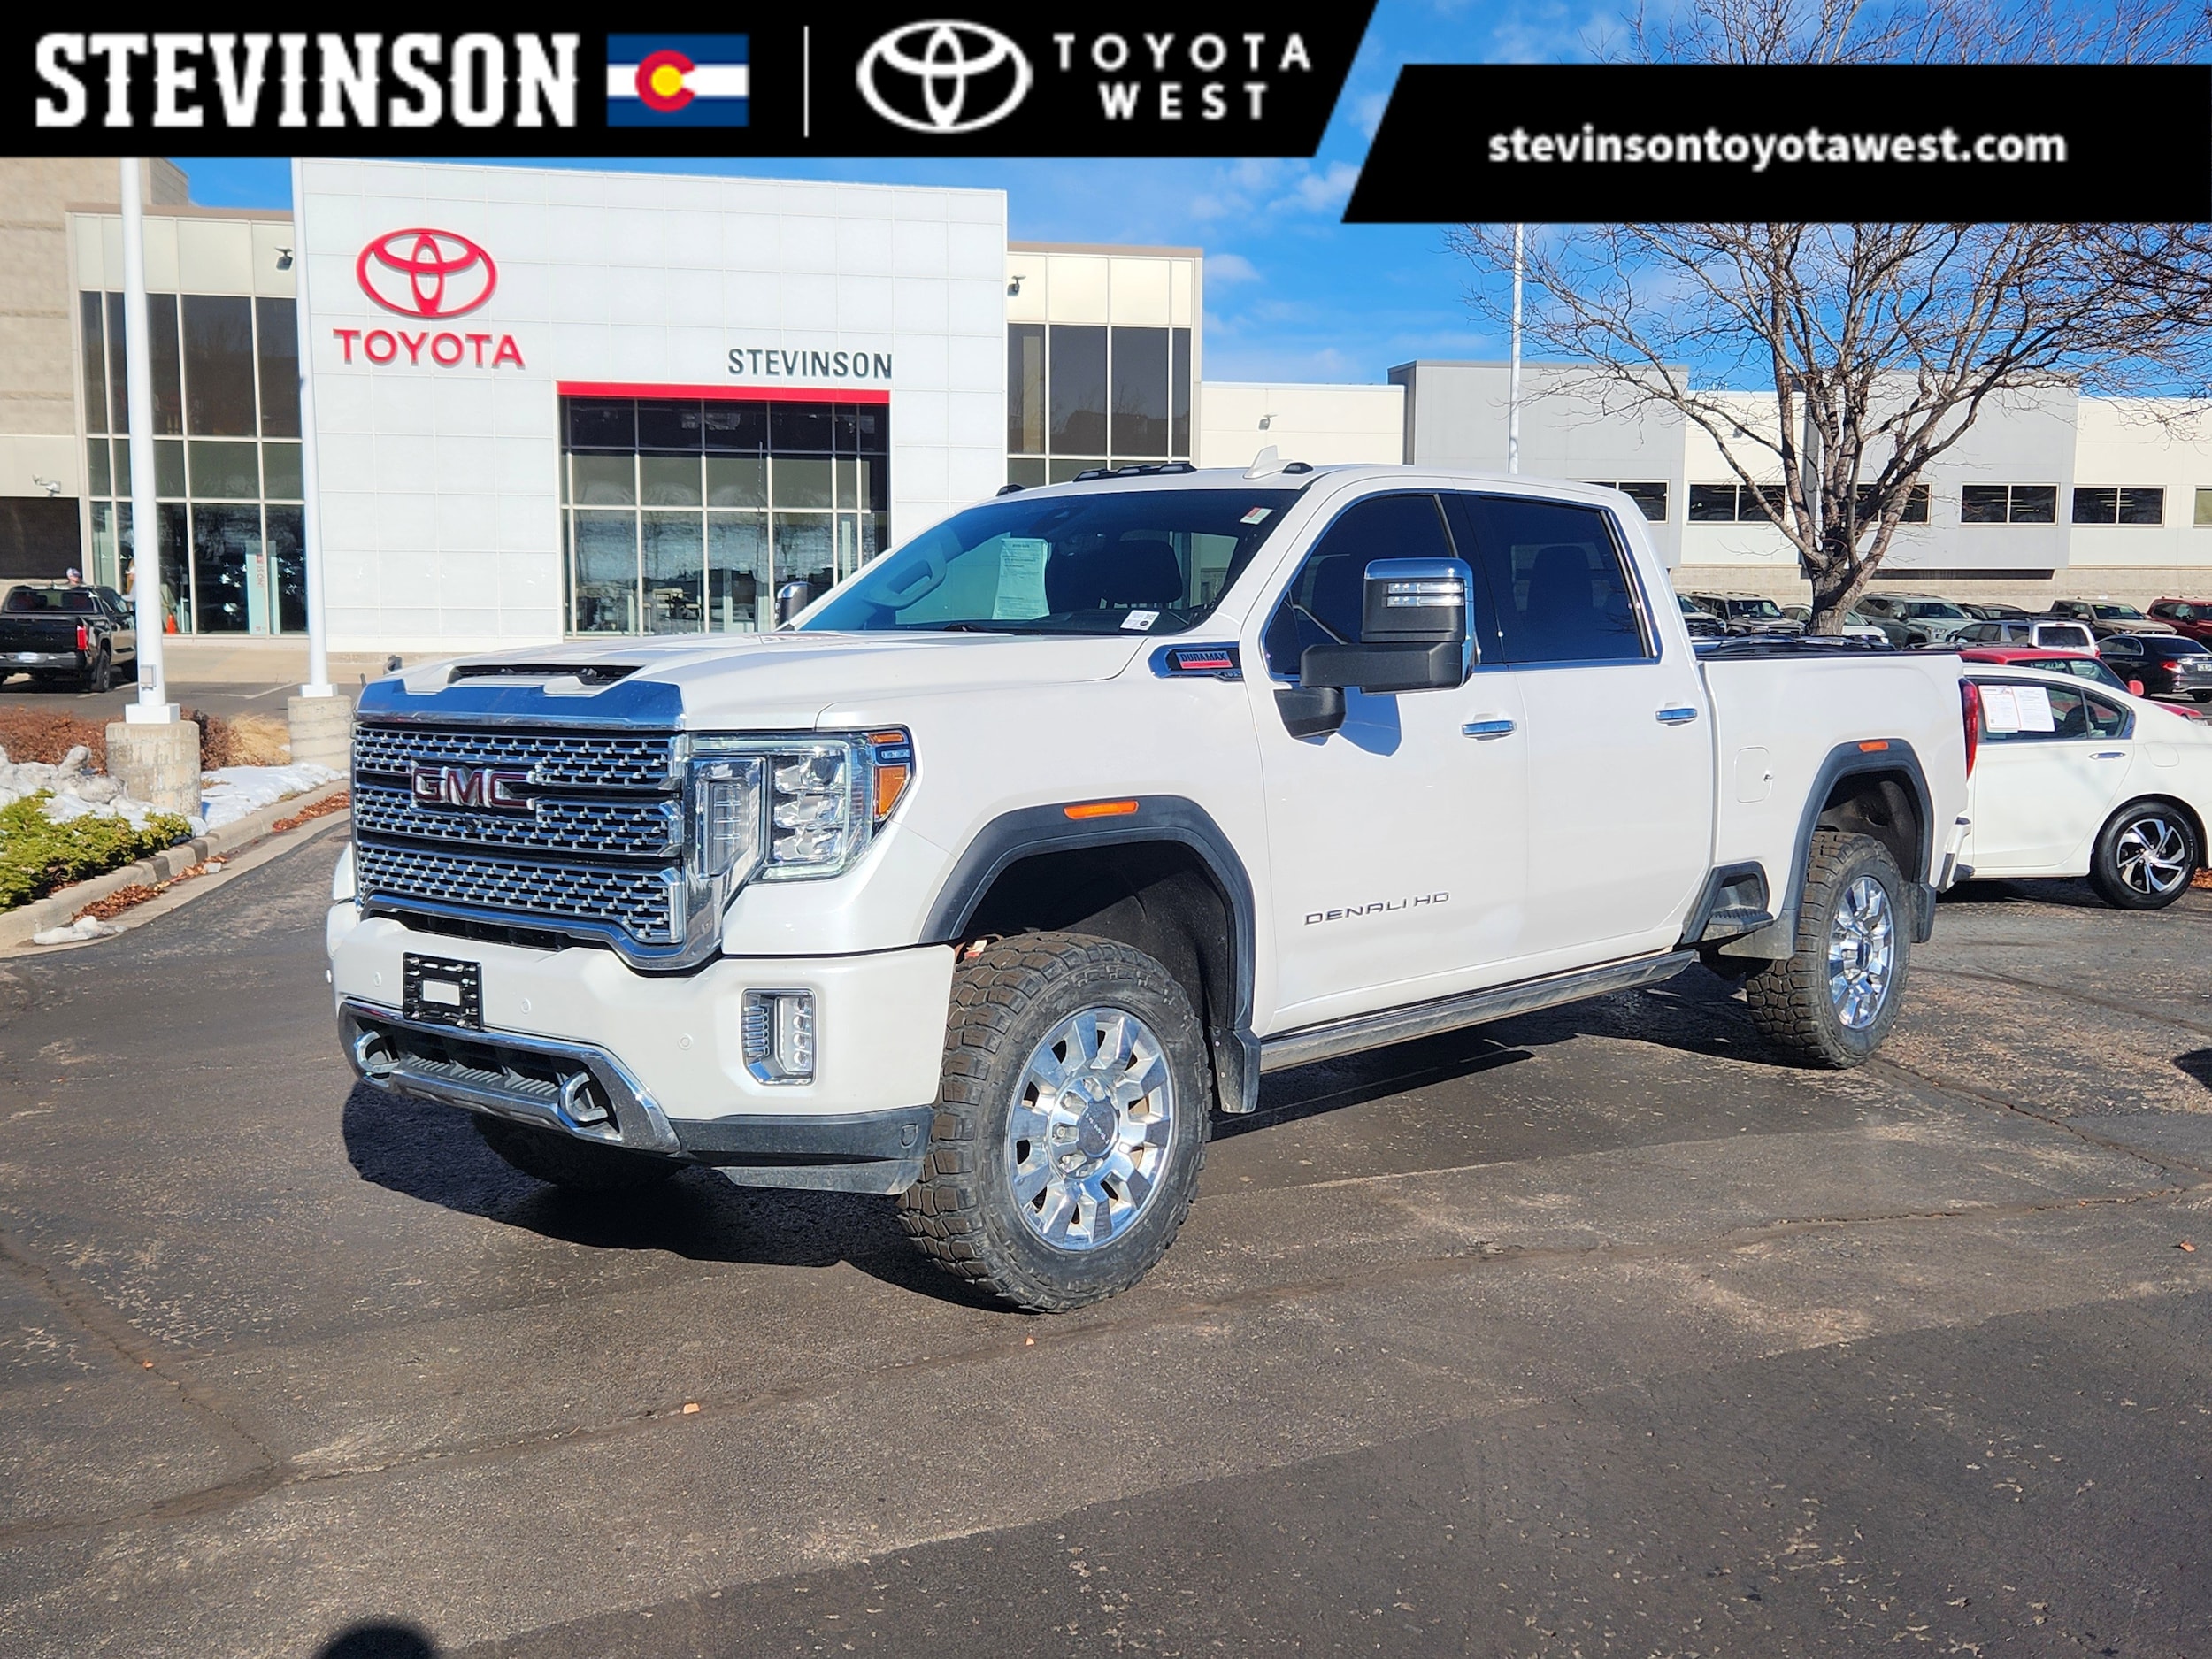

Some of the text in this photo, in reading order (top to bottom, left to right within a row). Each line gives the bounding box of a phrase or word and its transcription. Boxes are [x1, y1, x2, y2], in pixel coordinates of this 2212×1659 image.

[334, 329, 524, 366] TOYOTA
[728, 349, 892, 379] STEVINSON
[1179, 651, 1226, 662] DURAMAX
[411, 766, 537, 810] GMC
[1304, 892, 1450, 926] DENALI HD
